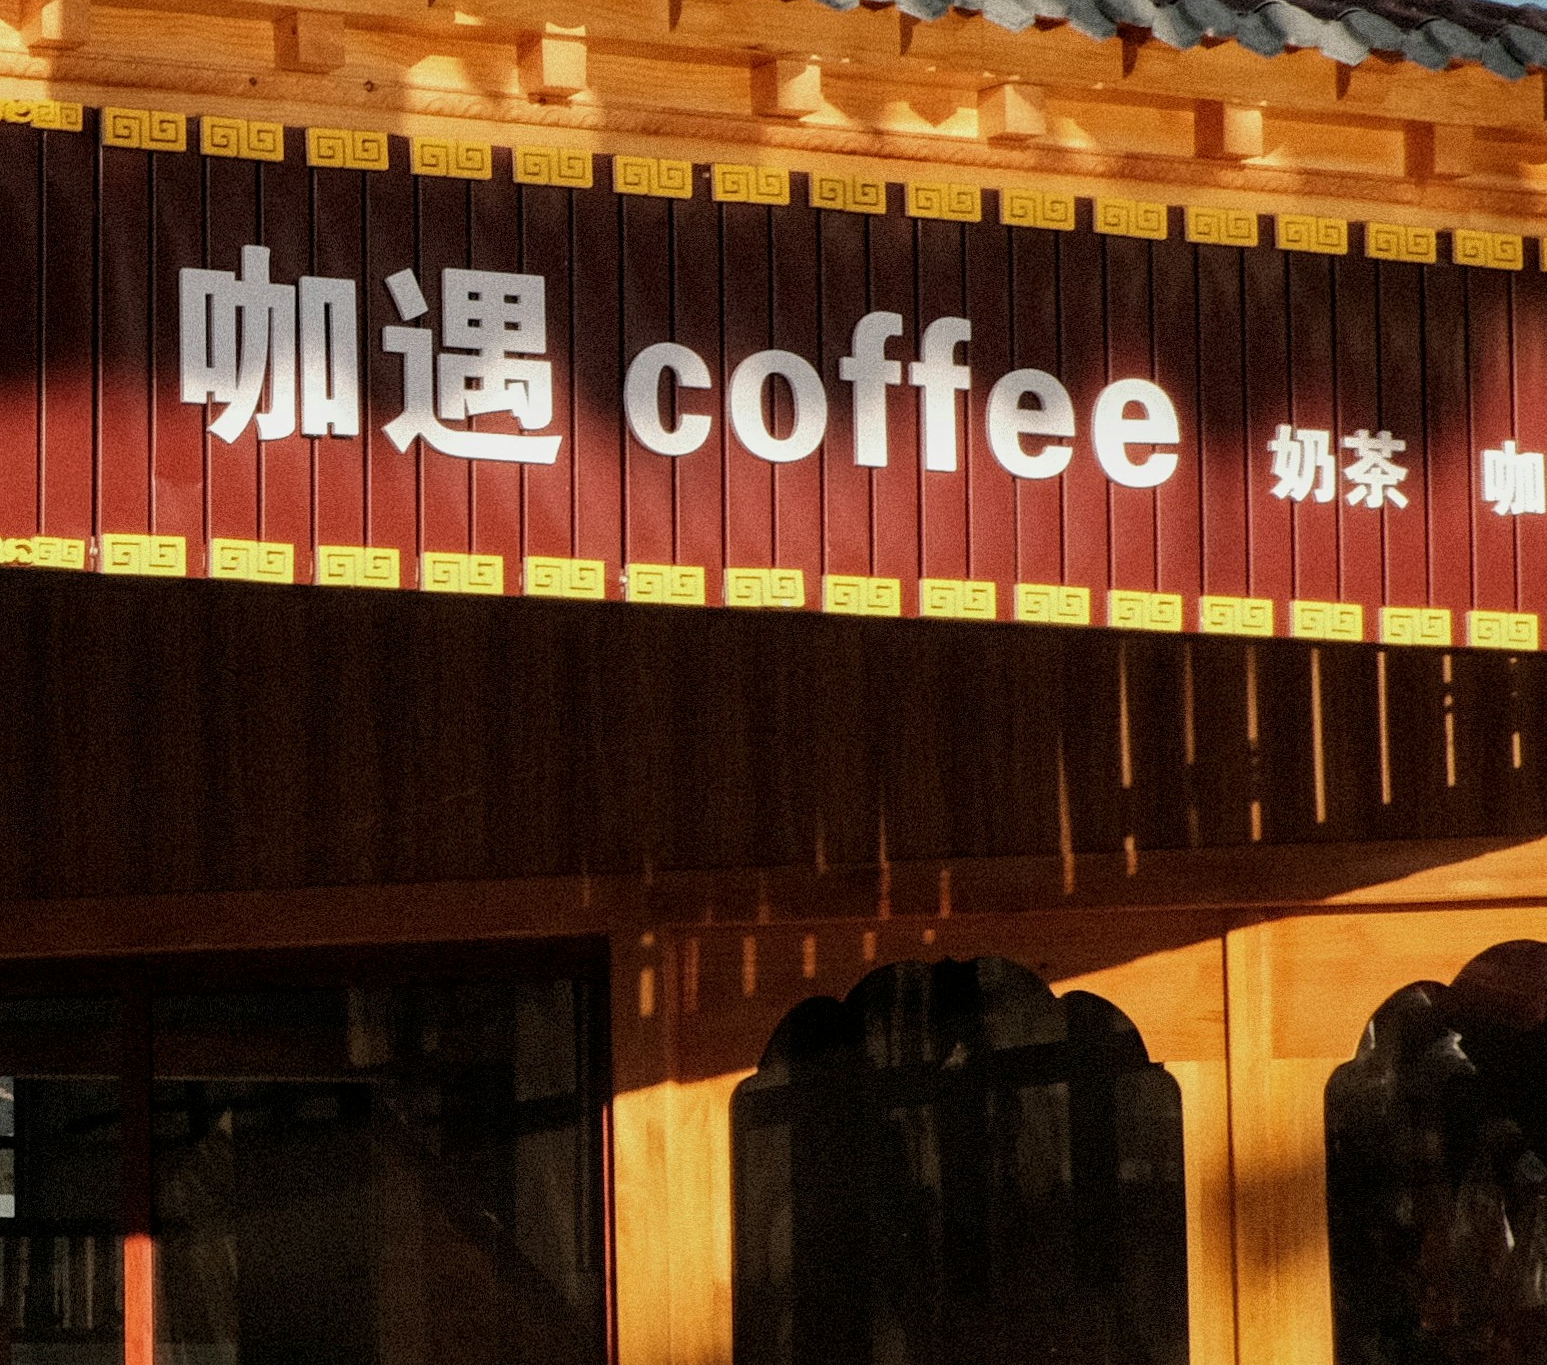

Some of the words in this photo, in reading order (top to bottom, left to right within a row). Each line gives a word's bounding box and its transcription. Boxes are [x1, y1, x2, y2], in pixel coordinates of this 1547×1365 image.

[178, 244, 564, 464] 咖遇
[623, 310, 1181, 489] coffee
[1268, 423, 1410, 510] 奶茶
